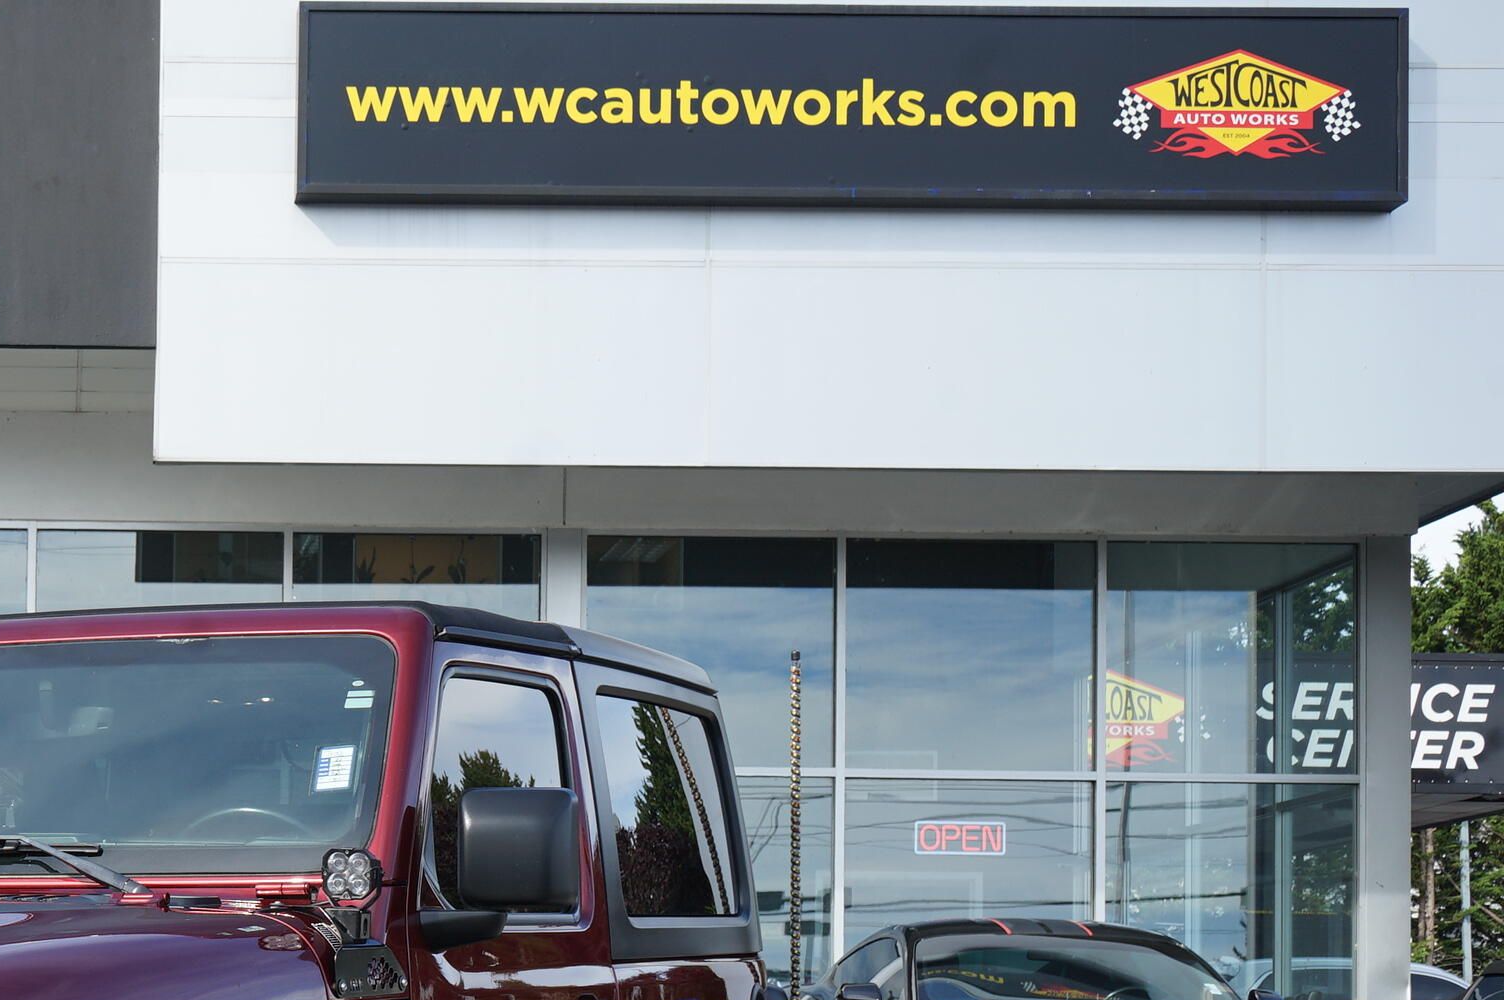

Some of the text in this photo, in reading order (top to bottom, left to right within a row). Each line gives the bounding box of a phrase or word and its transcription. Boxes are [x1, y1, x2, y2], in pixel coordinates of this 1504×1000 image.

[346, 78, 1076, 128] www.wcautoworks.com
[1173, 113, 1300, 126] AUTO WORKS
[919, 824, 1002, 852] OPEN
